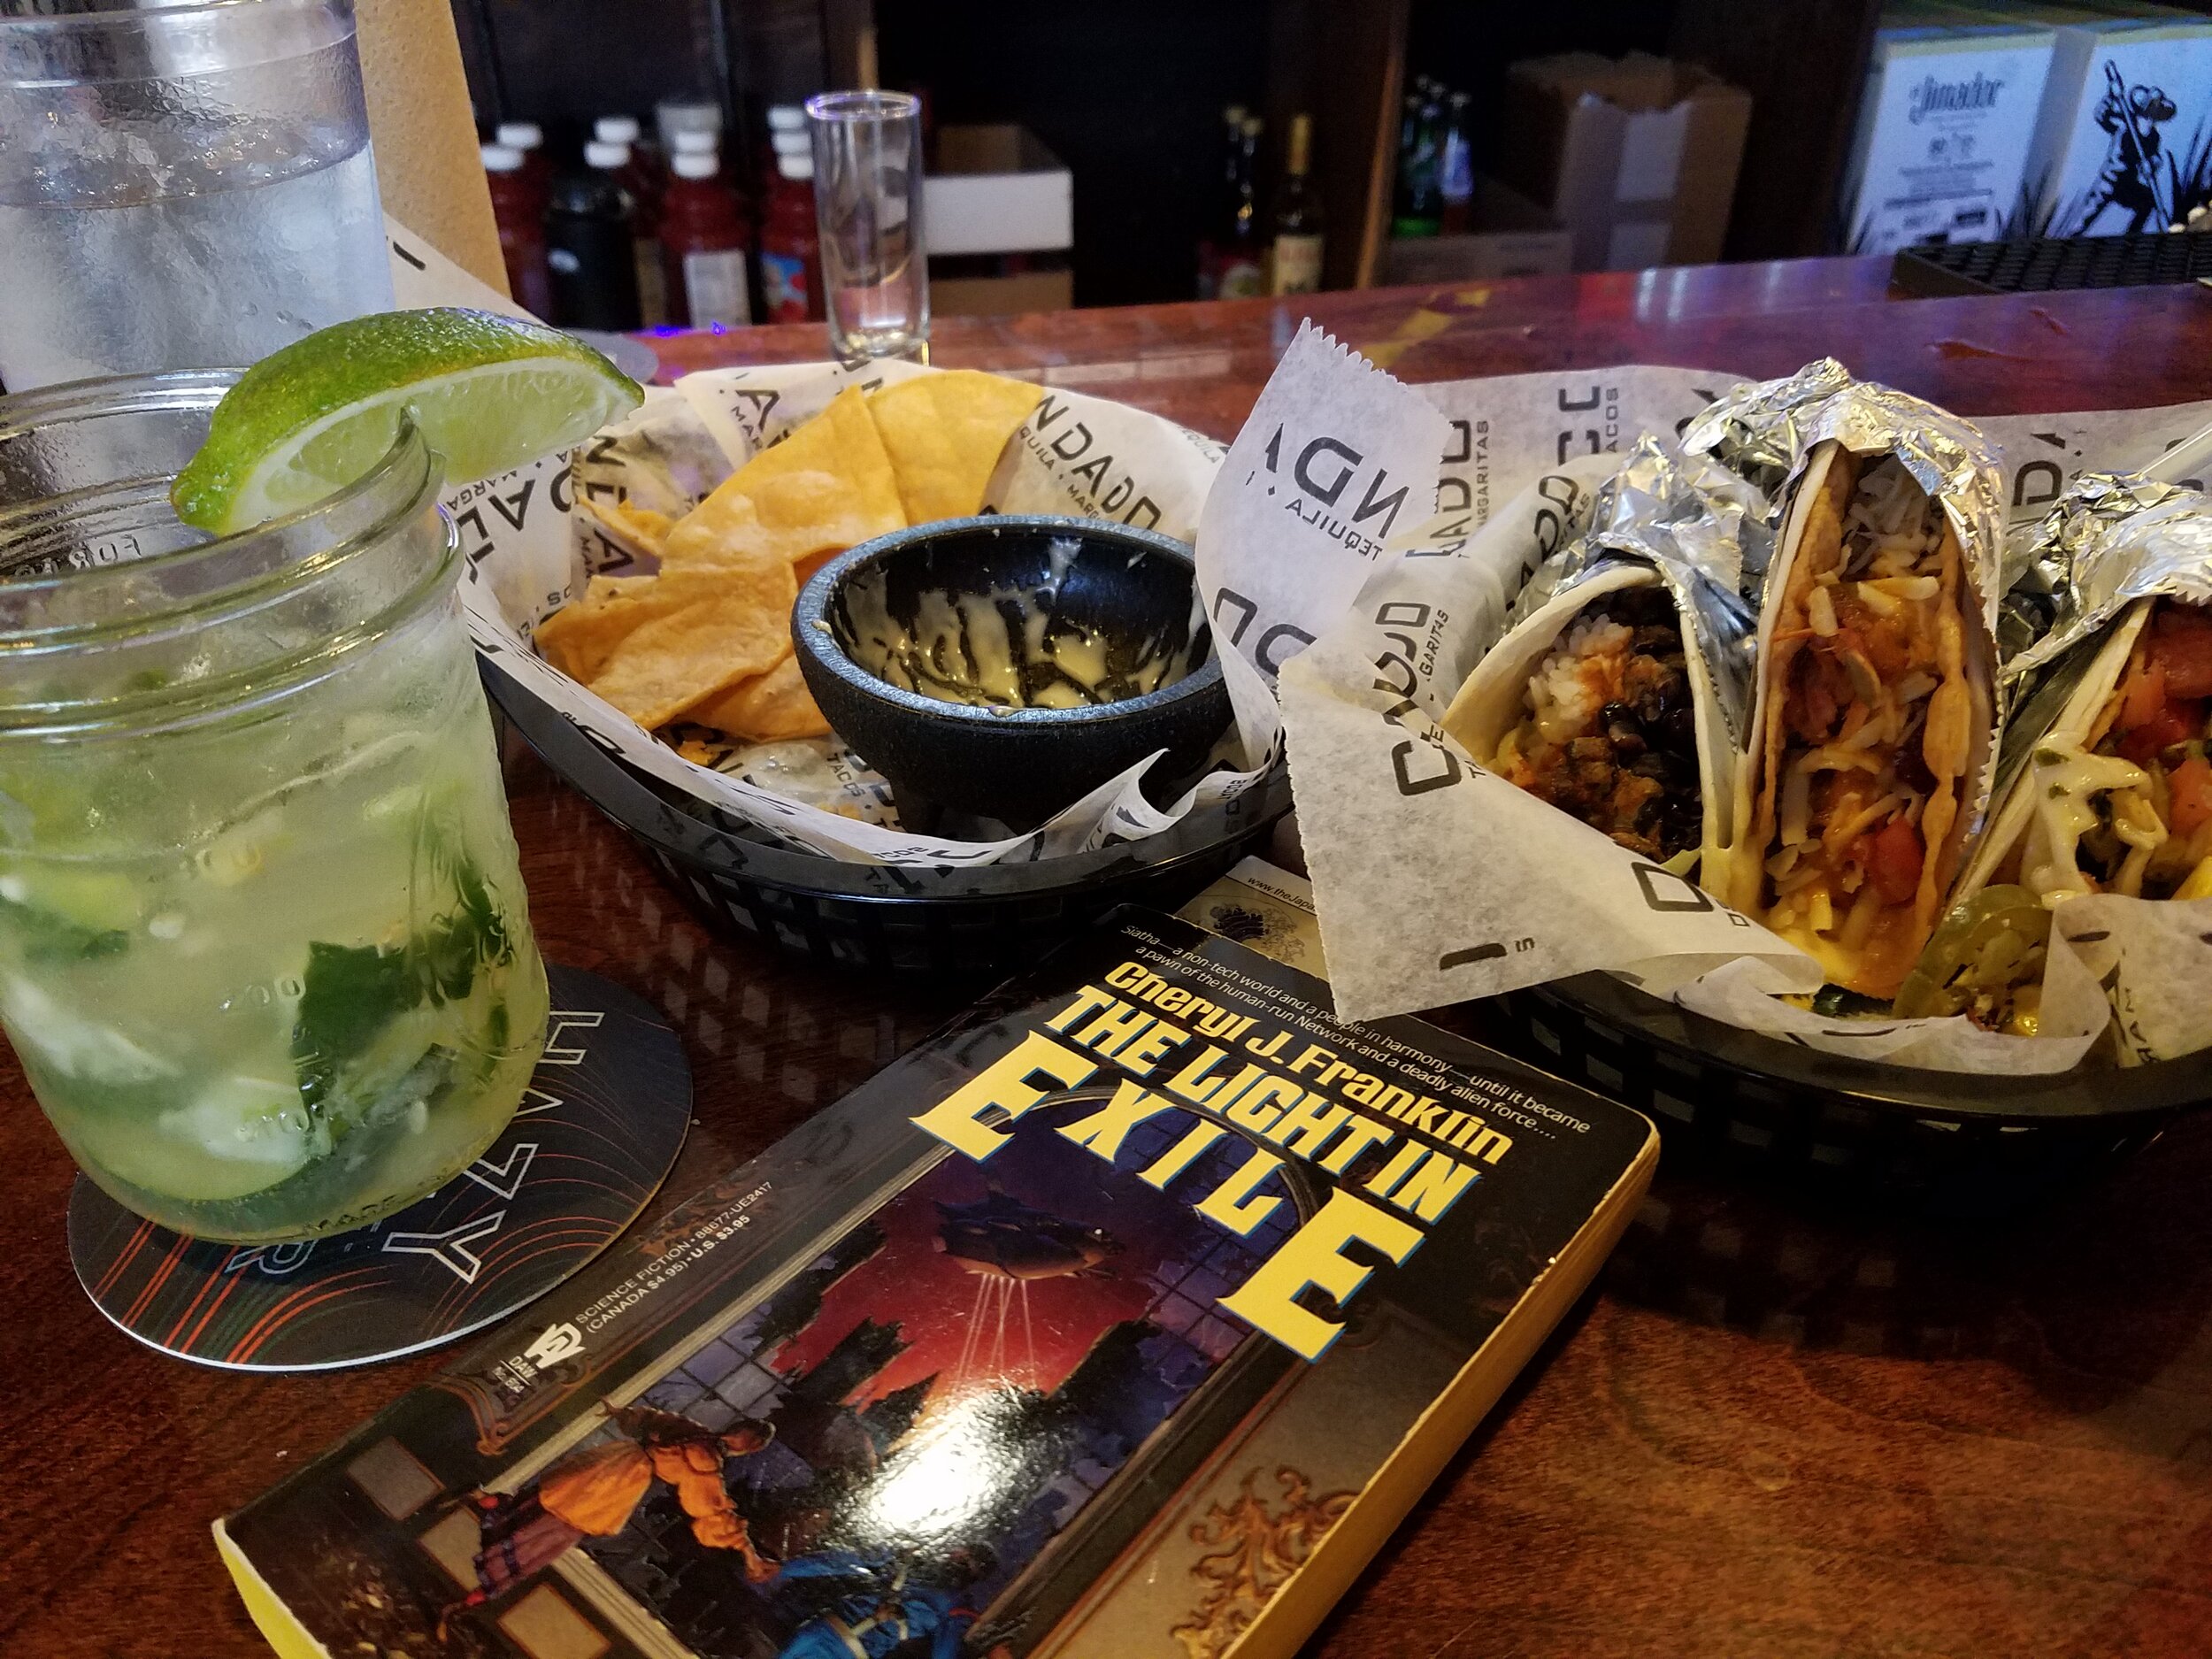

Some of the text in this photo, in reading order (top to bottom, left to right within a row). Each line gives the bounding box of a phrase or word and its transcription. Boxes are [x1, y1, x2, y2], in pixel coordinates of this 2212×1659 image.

[1019, 426, 1056, 471] QUILA
[1035, 395, 1161, 529] NDADO
[1606, 388, 1618, 453] ACOS
[1419, 610, 1450, 675] GARITAS
[1104, 961, 1513, 1165] Cheryl J. Franklin
[1135, 946, 1148, 955] a
[1142, 950, 1182, 971] pawn
[1180, 966, 1200, 978] of
[1196, 972, 1220, 987] the
[1218, 981, 1295, 1022] human-run
[1294, 1016, 1361, 1050] Network
[1357, 1044, 1394, 1063] and
[1387, 1058, 1401, 1068] a
[1399, 1064, 1455, 1092] deadly
[1450, 1084, 1491, 1109] alien
[1182, 951, 1239, 981] non-tech
[1240, 976, 1282, 998] world
[1279, 994, 1311, 1010] and
[1365, 1029, 1381, 1042] in
[1508, 1090, 1525, 1104] it
[1523, 1096, 1591, 1133] became
[1041, 985, 1484, 1226] THE LIGHT IN
[910, 1030, 1424, 1363] EXILE
[575, 1279, 638, 1323] SCIENCE
[636, 1241, 691, 1280] FICTION
[587, 1287, 649, 1333] (CANADA
[716, 1215, 750, 1240] $3.95
